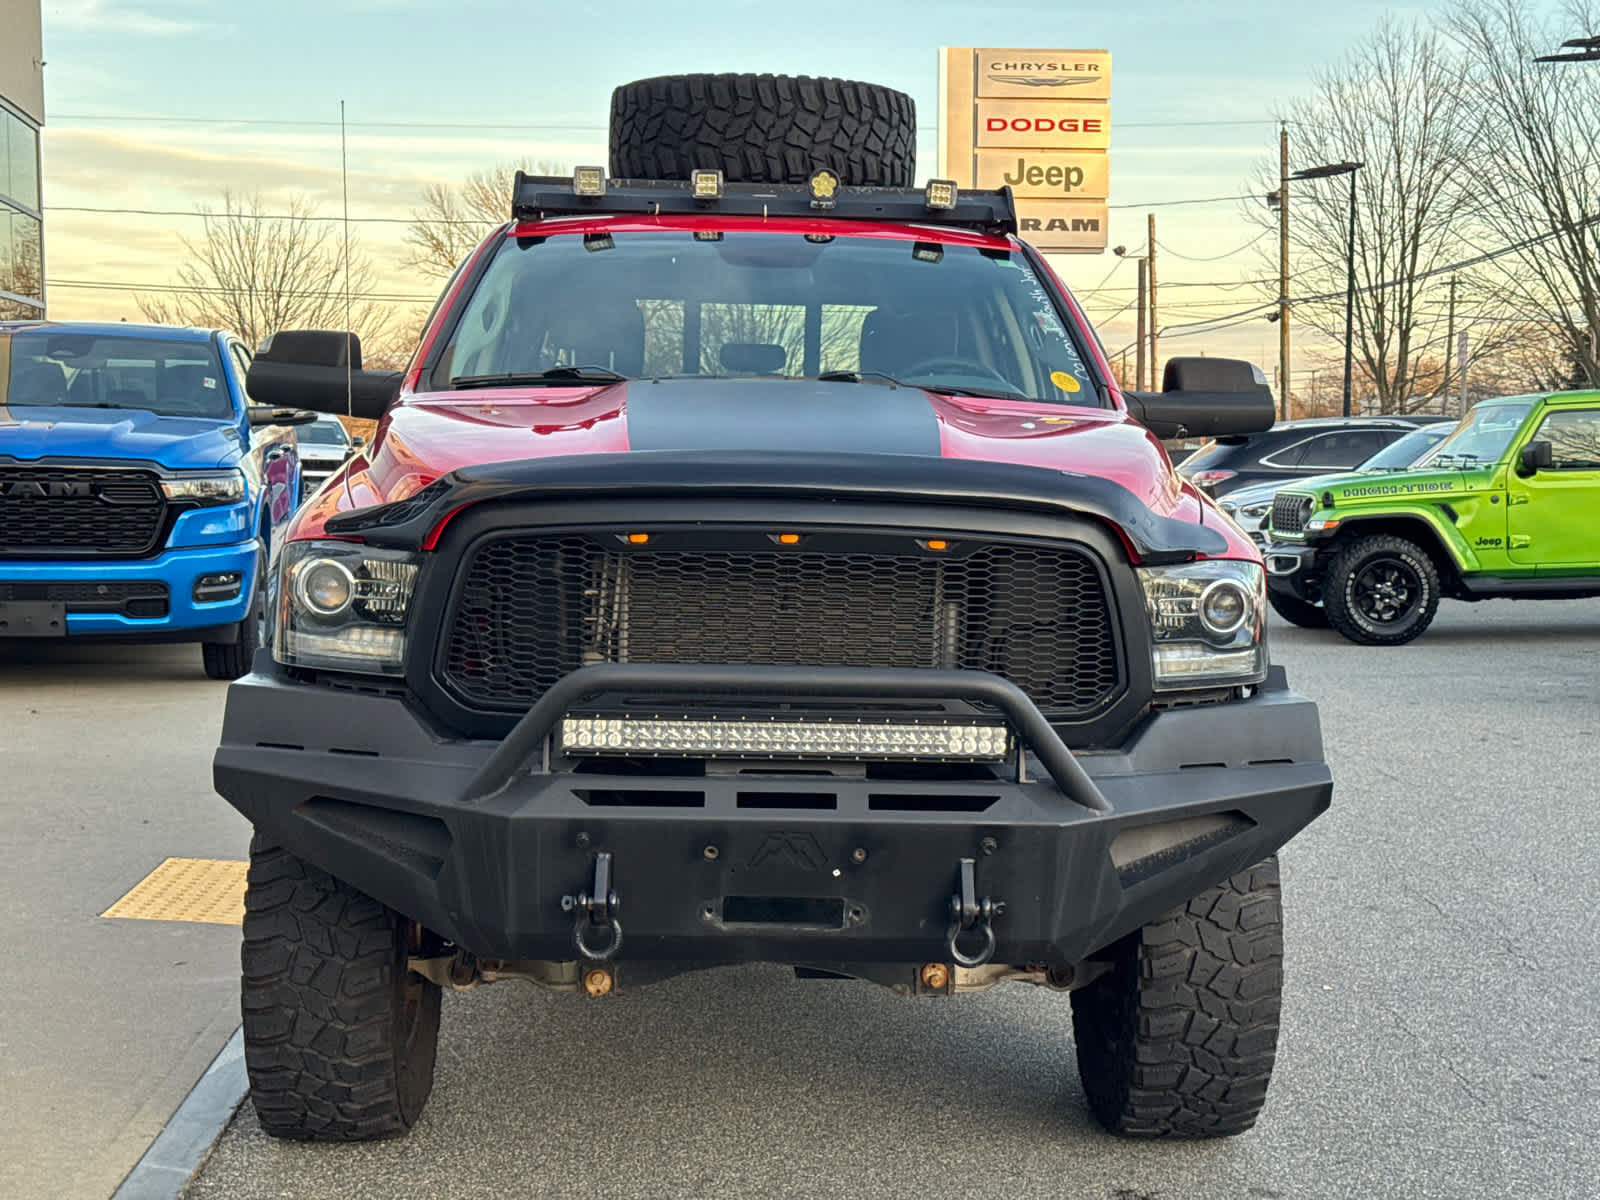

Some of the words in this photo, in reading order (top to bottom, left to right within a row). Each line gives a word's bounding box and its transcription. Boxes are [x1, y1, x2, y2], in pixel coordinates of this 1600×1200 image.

[990, 62, 1100, 72] CHRYSLER
[986, 118, 1102, 132] DODGE
[1004, 158, 1084, 192] Jeep
[1020, 218, 1100, 232] RAM
[0, 481, 90, 496] AM
[1475, 536, 1502, 546] Jeep
